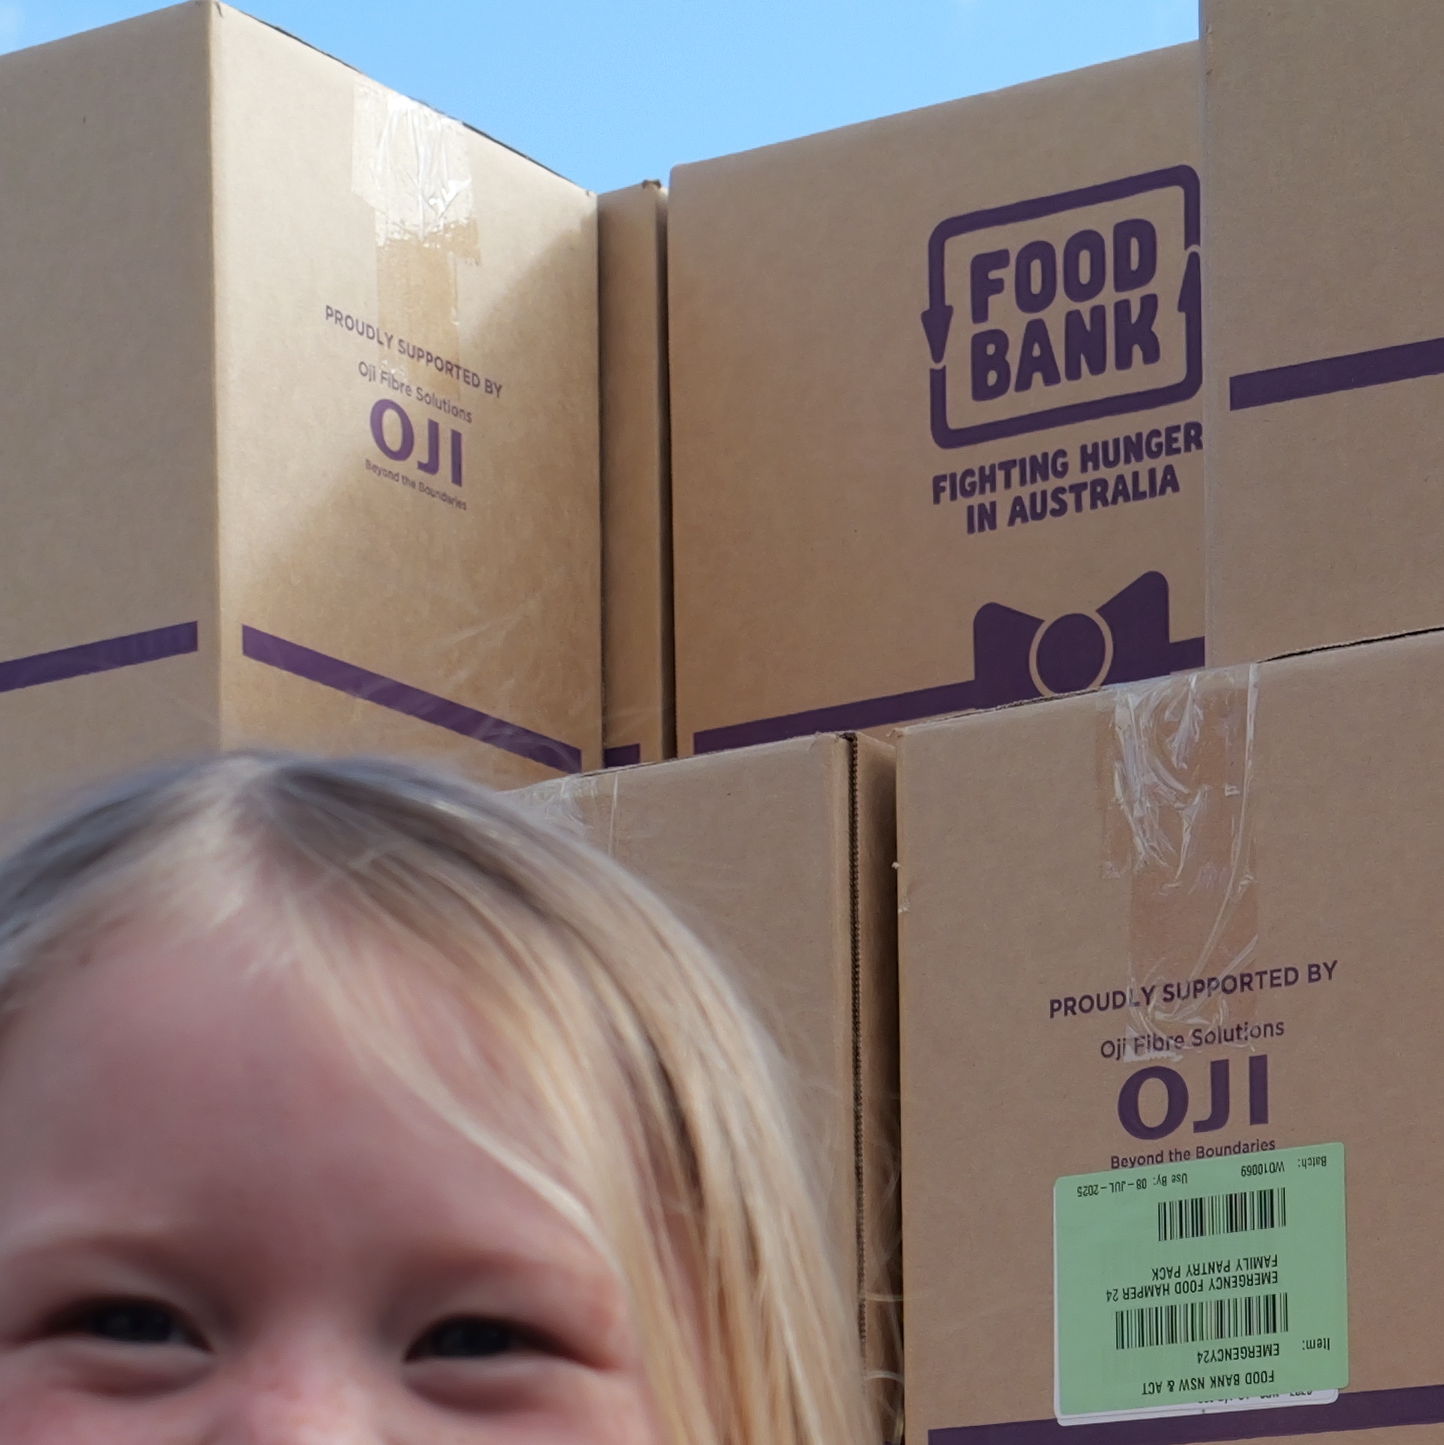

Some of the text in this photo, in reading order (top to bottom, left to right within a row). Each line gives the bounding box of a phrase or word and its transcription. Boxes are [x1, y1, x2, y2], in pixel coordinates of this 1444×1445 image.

[970, 218, 1157, 325] FOOD
[325, 305, 503, 399] PROUDLY SUPPORTED BY
[971, 290, 1161, 403] BANK
[380, 371, 413, 396] Fibre
[416, 387, 473, 424] Solutions
[369, 398, 463, 488] OJI
[932, 421, 1204, 505] FIGHTING HUNGER
[966, 463, 1180, 535] IN AUSTRALIA
[1049, 960, 1339, 1019] PROUDLY SUPPORTED BY
[1100, 1019, 1285, 1060] Oji Fibre Solutions
[1117, 1054, 1269, 1140] OJI
[1110, 1137, 1276, 1170] Beyond the Boundaries
